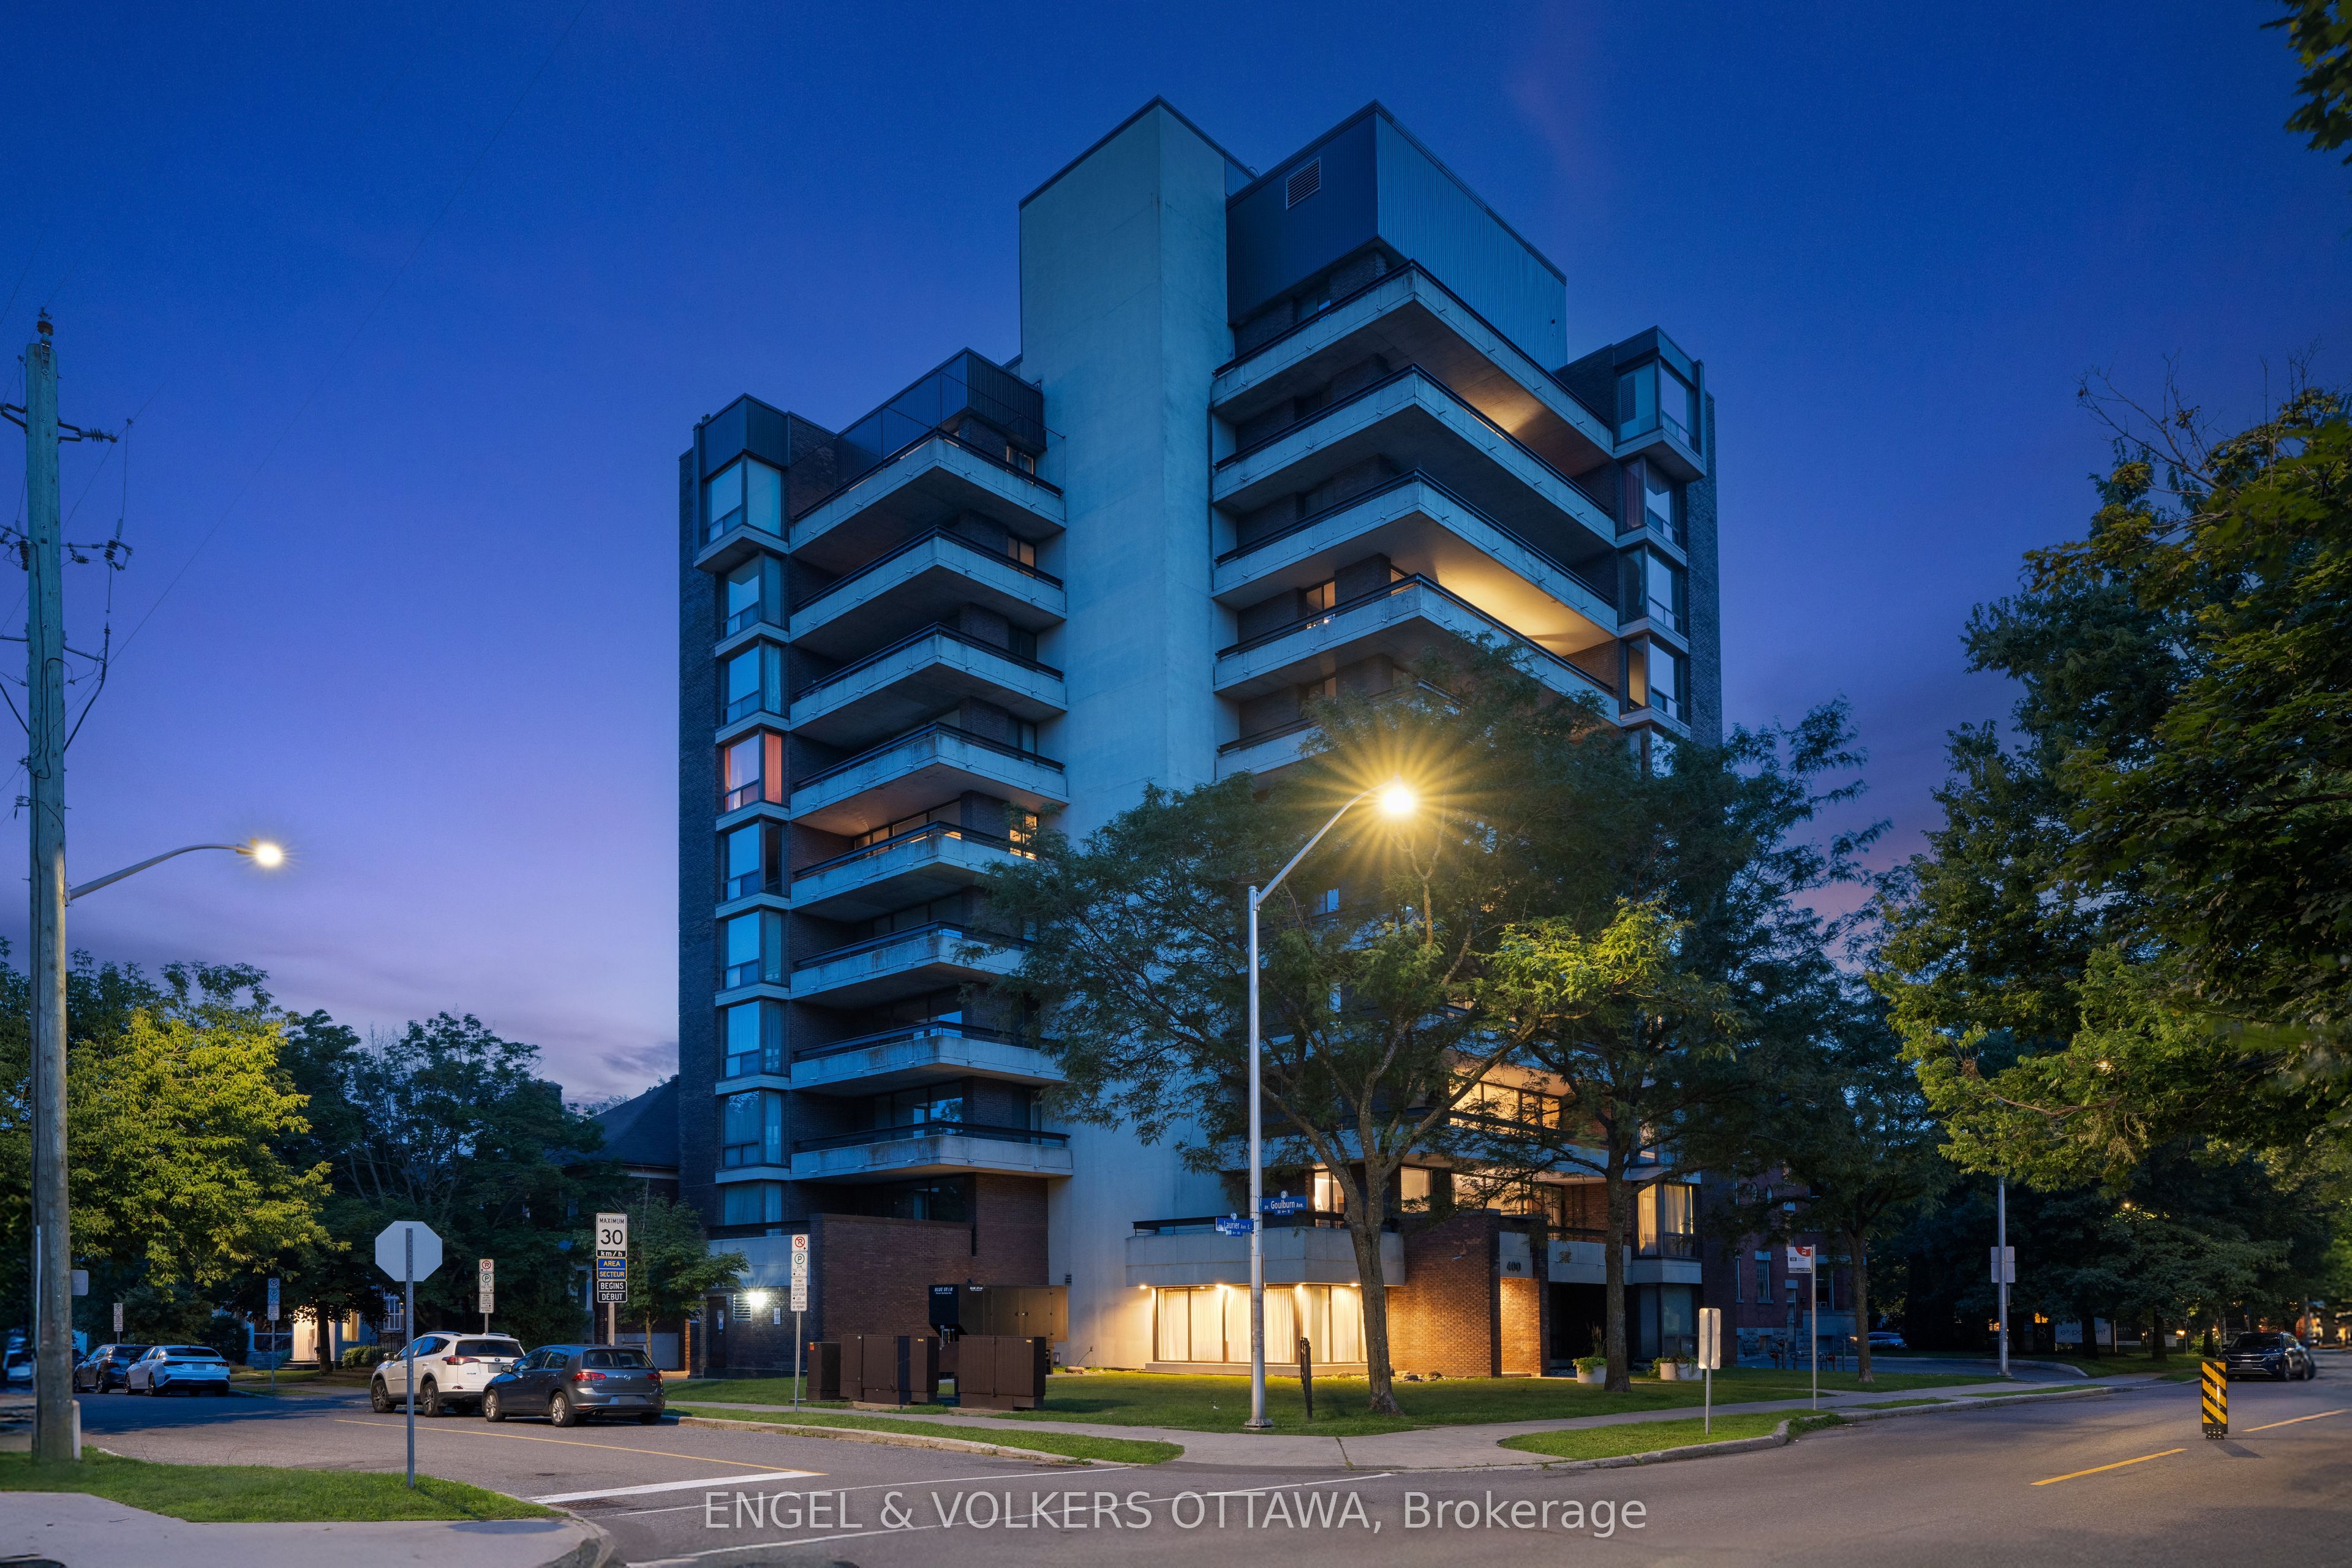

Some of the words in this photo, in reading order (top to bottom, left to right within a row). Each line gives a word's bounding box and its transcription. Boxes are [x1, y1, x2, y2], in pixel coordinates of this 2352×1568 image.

[1271, 1199, 1295, 1209] Goulburn
[1224, 1220, 1240, 1229] Laurier
[600, 1229, 623, 1245] 30
[1507, 1261, 1521, 1272] 400
[2037, 1327, 2047, 1340] 8
